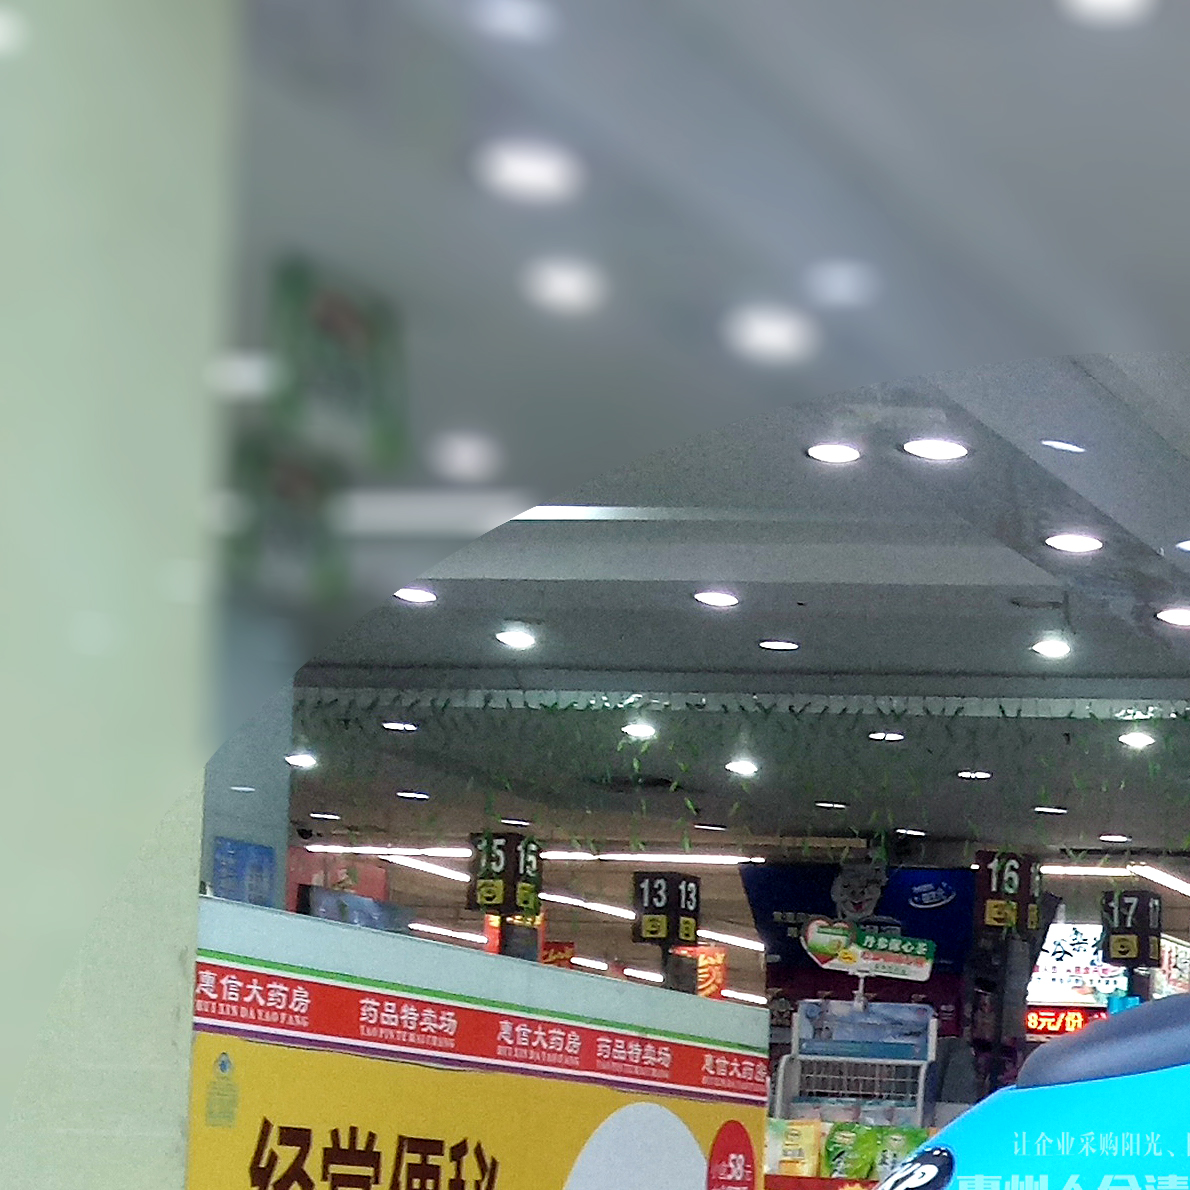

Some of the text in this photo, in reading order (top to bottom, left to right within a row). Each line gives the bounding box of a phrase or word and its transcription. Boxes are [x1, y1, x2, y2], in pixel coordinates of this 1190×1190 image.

[639, 878, 668, 908] 13
[987, 858, 1021, 895] 16
[678, 880, 698, 912] 13
[1107, 896, 1139, 929] 17
[195, 970, 312, 1014] 惠信大药房
[359, 997, 459, 1037] 药品特卖场
[496, 1019, 582, 1056] 惠信大药房
